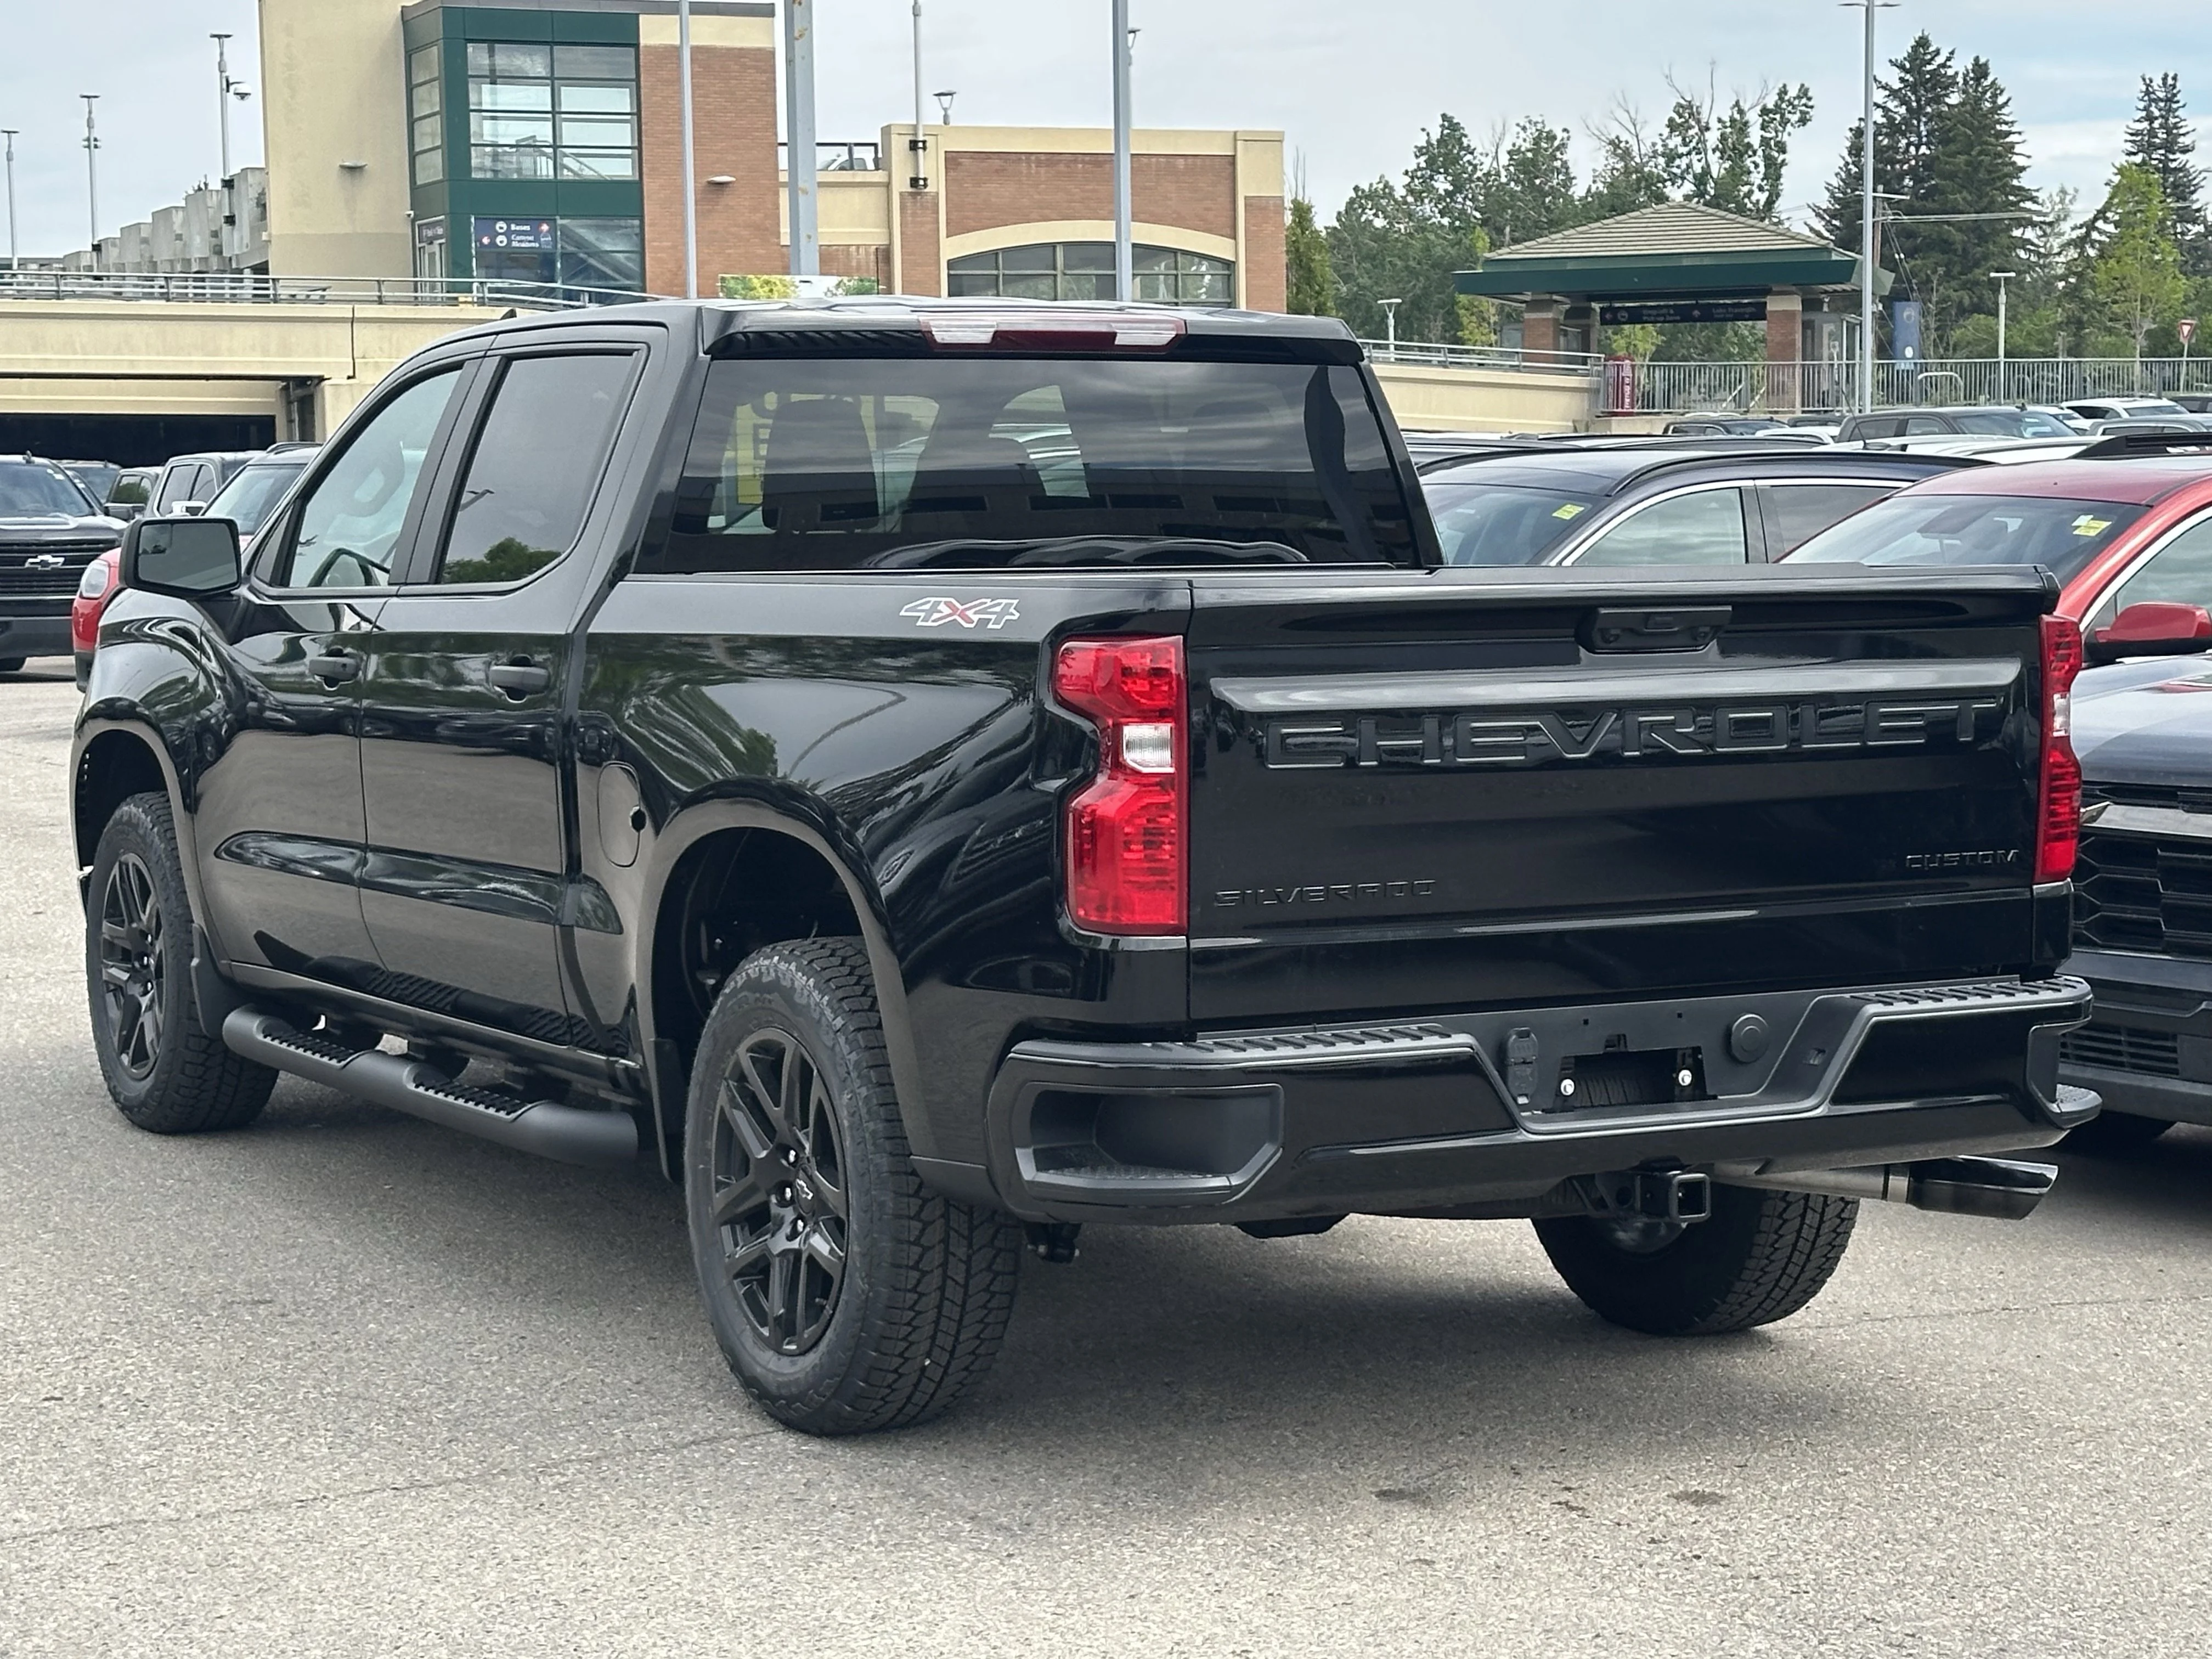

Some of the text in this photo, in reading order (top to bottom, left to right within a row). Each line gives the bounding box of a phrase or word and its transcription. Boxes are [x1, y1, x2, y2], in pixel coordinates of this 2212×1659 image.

[1264, 696, 1997, 768] CHEVROLET
[1906, 849, 2019, 869] CUSTOM
[1214, 879, 1436, 907] SILVERADO
